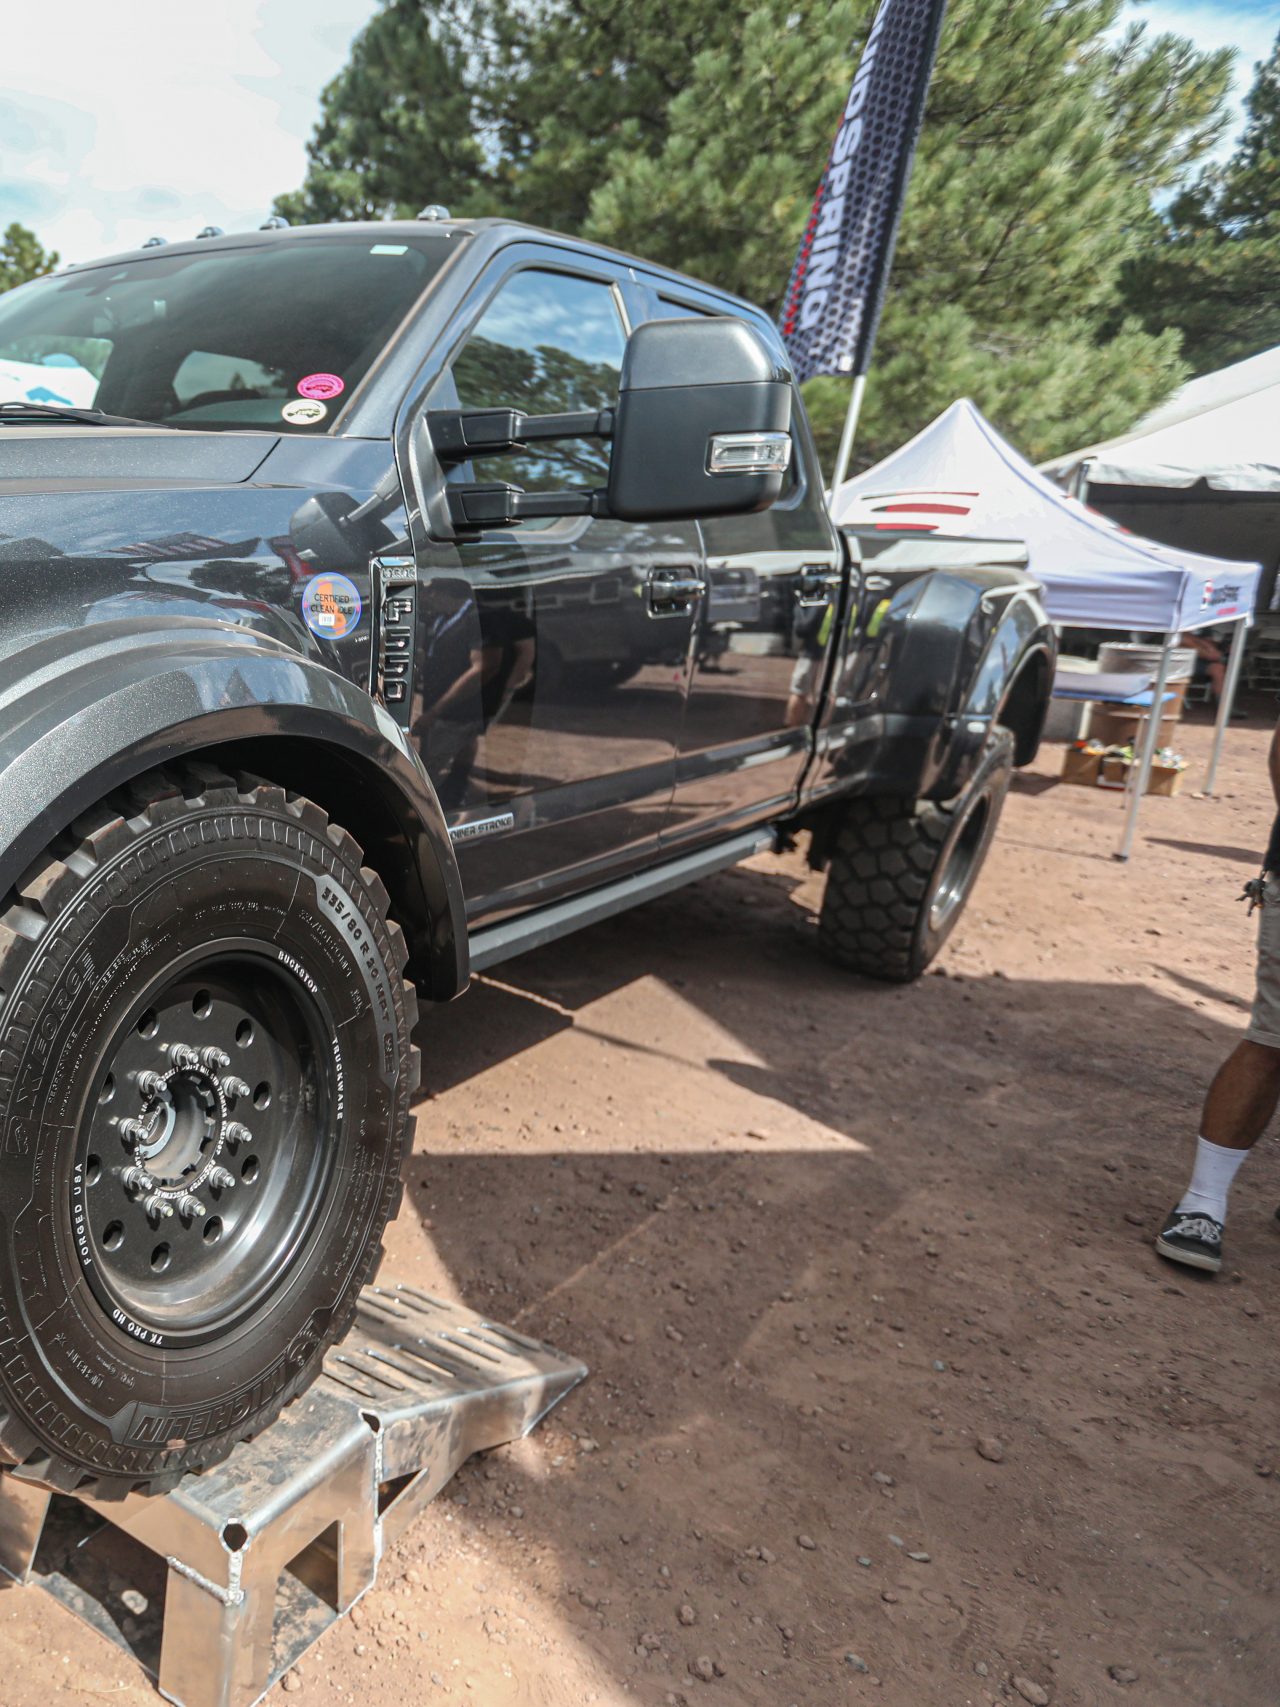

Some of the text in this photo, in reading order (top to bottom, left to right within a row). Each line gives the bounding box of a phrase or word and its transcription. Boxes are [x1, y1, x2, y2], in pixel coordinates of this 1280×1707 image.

[310, 604, 335, 614] CLEAN
[314, 593, 350, 603] CERTIFIED
[359, 943, 371, 955] R
[277, 950, 345, 1121] BUCKSTOP TRUCKWARE
[73, 1162, 92, 1266] FORGED USA
[112, 1308, 164, 1346] 7K PRO HD
[130, 1361, 287, 1443] MICHELIN
